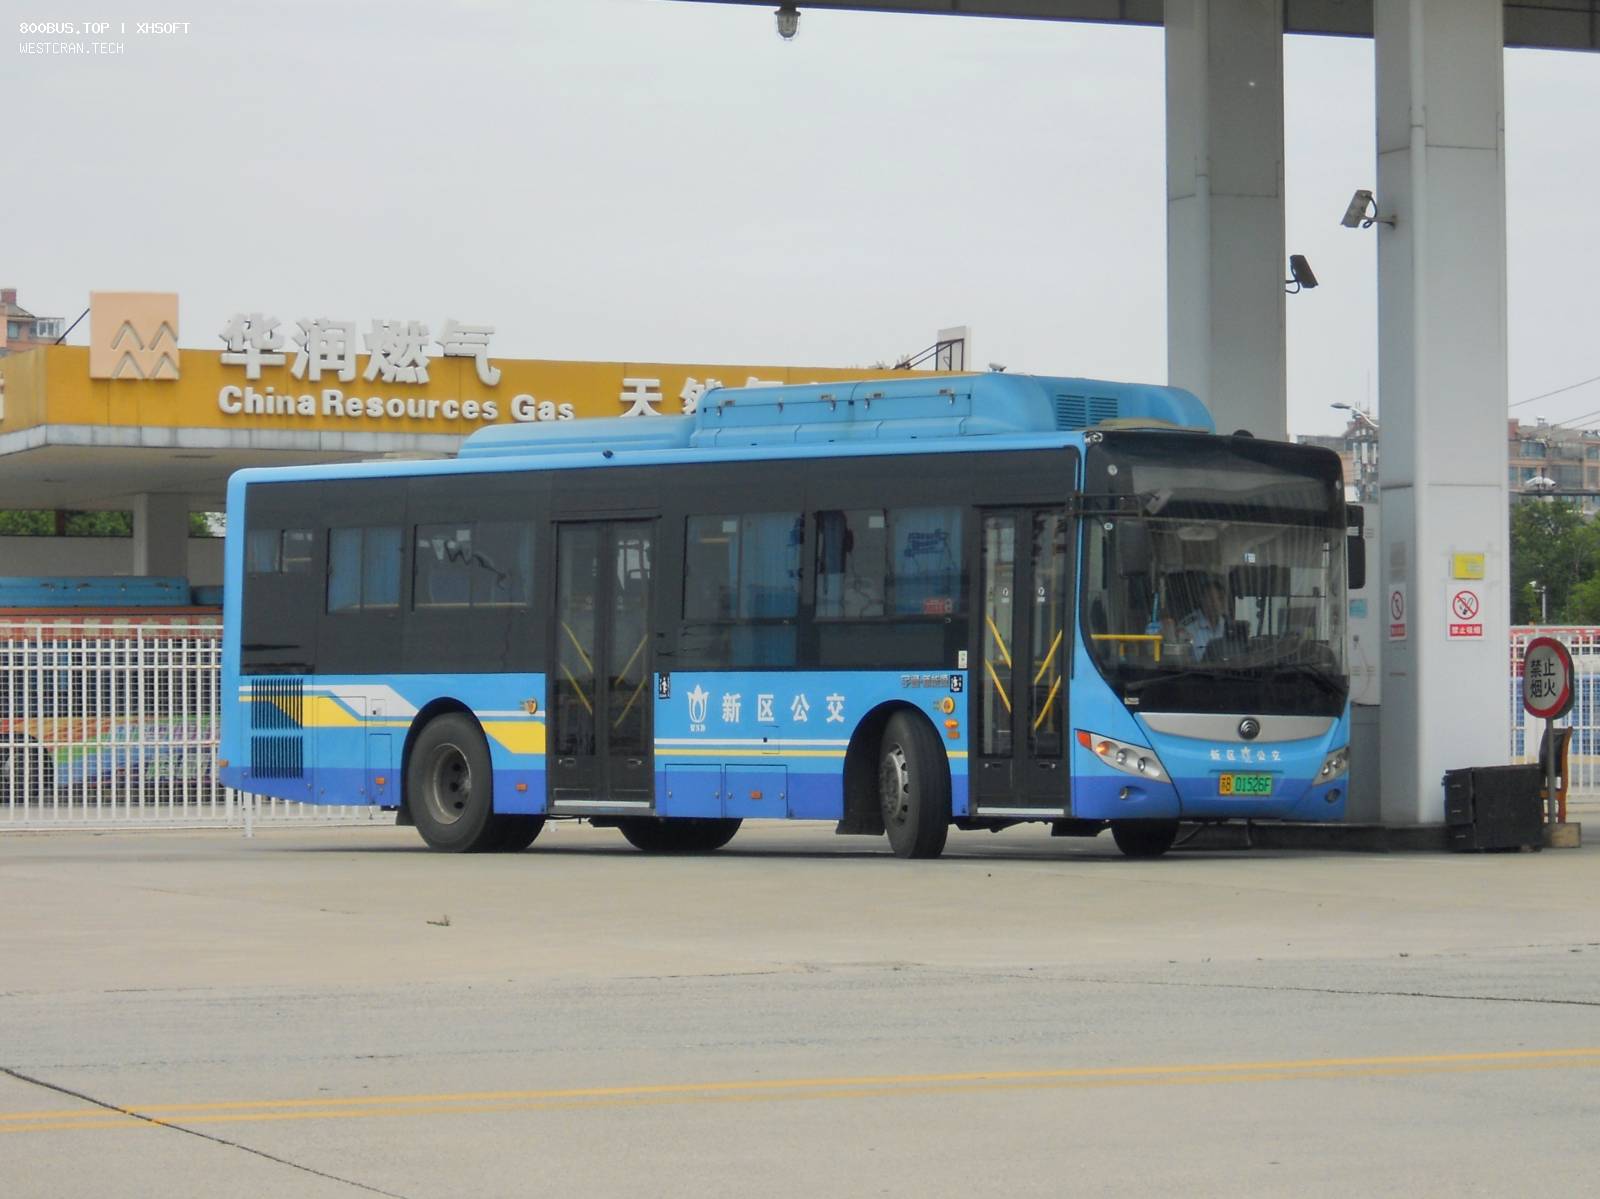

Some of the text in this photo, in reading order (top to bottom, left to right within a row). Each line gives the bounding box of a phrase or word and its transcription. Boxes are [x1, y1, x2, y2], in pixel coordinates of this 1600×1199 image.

[218, 311, 501, 388] 华润燃气
[218, 385, 575, 423] China Resources Gas
[1529, 657, 1556, 678] 禁止
[1529, 678, 1557, 698] 烟火
[721, 692, 846, 724] 新区公交
